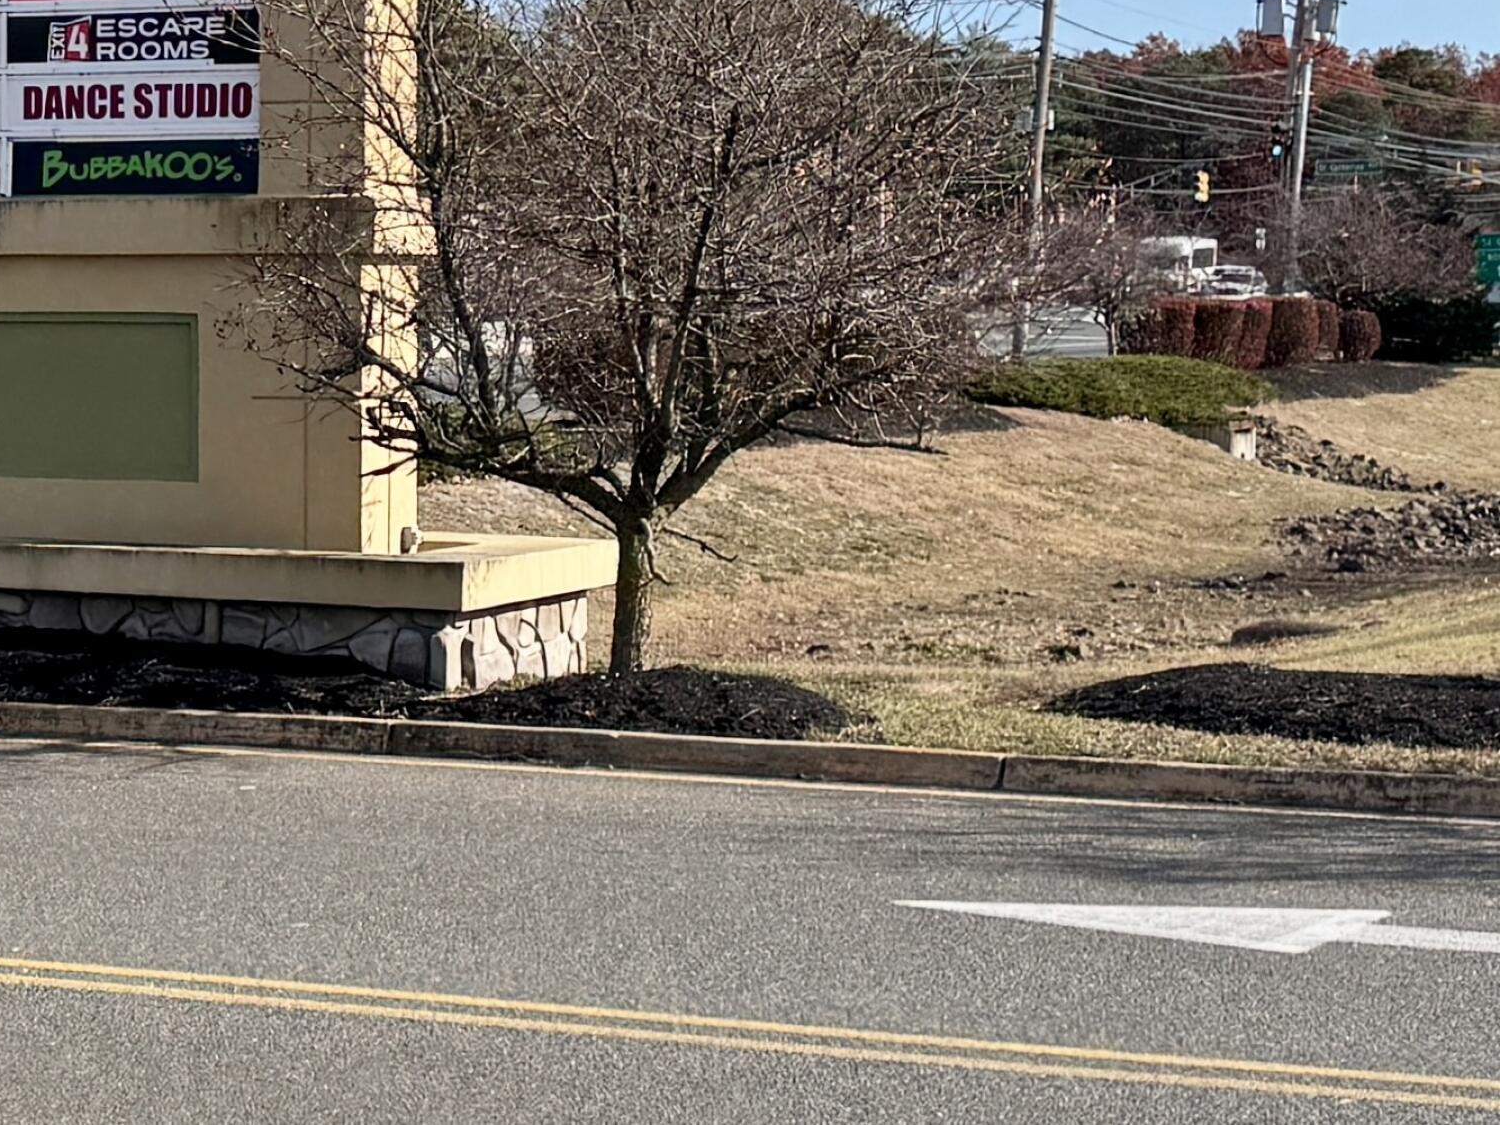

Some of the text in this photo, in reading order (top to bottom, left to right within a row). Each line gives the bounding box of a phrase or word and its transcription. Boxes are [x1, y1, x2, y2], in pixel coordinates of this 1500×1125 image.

[96, 16, 226, 38] ESCAPE
[51, 24, 89, 60] EXIT 4
[96, 40, 210, 60] ROOMS
[23, 82, 253, 120] DANCE STUDIO
